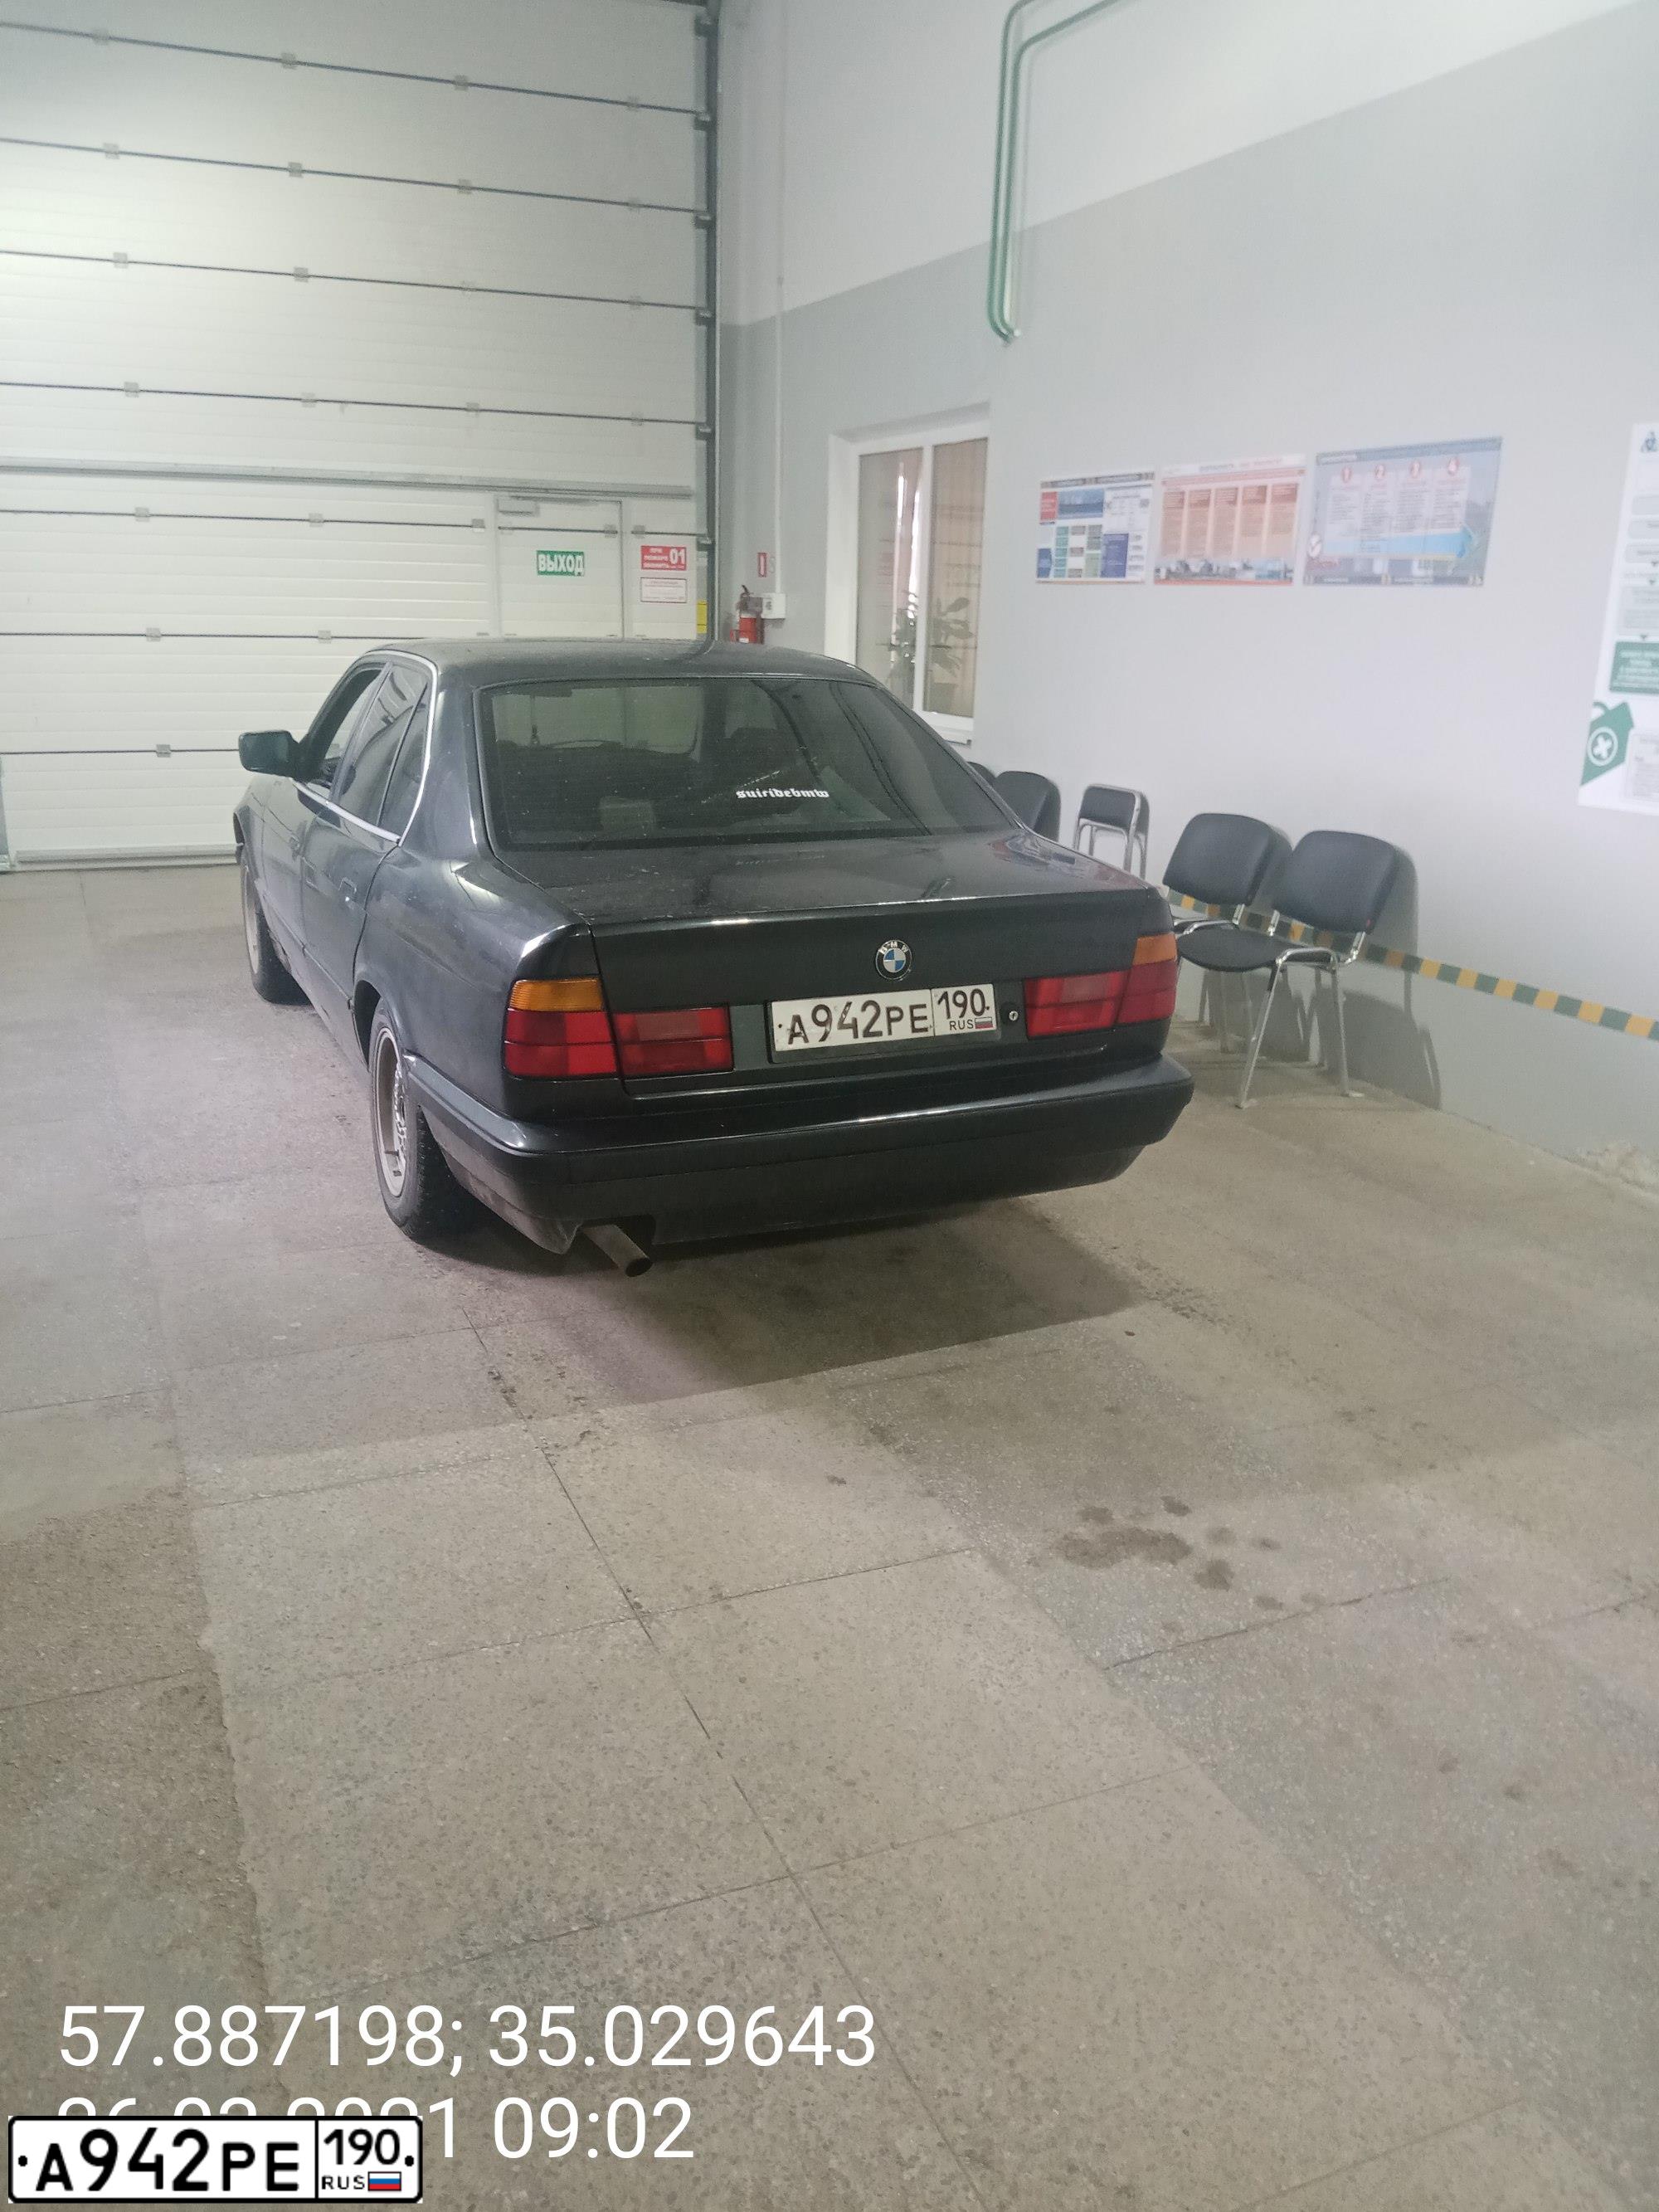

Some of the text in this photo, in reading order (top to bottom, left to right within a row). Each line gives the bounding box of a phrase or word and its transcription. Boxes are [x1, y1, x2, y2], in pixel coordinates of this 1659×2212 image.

[538, 553, 584, 576] ВЫХОД
[669, 547, 685, 565] 01
[878, 941, 909, 954] BMW
[937, 988, 986, 1020] 190
[949, 1019, 975, 1031] RUS
